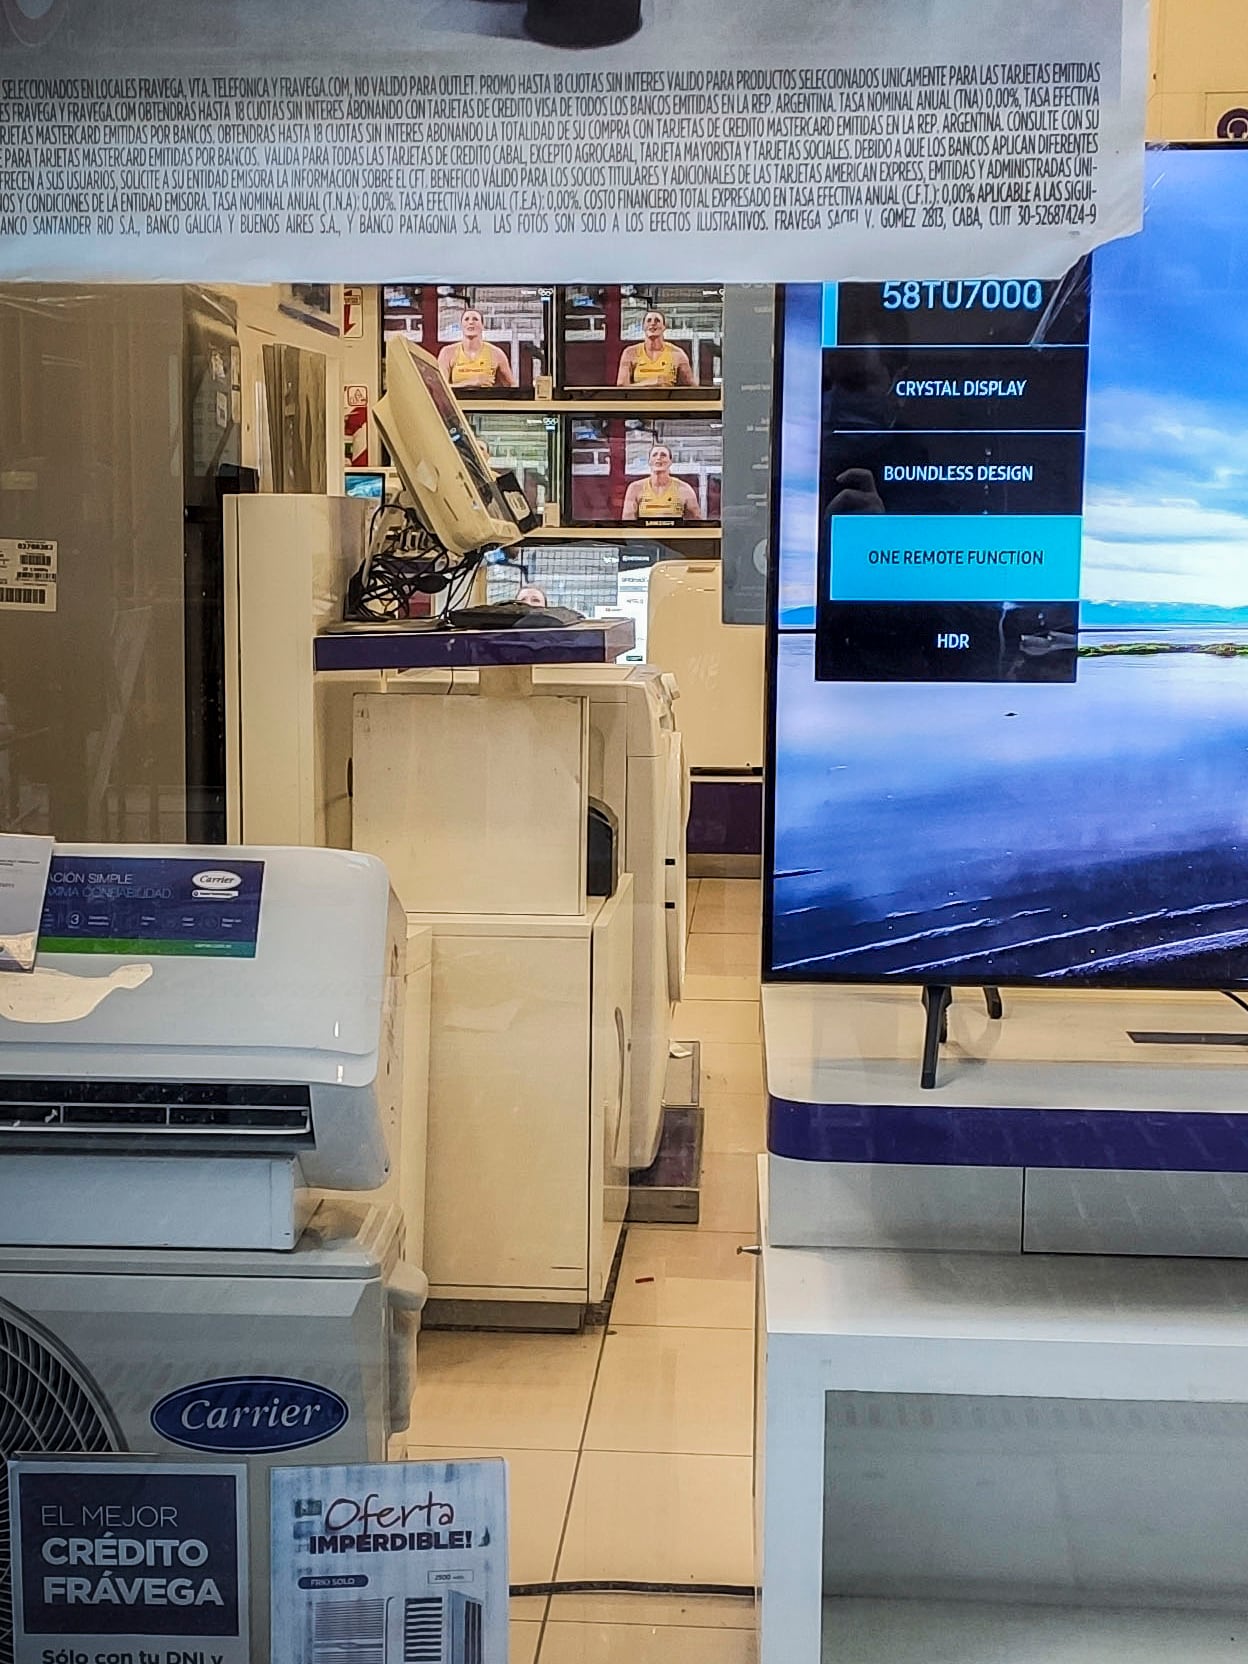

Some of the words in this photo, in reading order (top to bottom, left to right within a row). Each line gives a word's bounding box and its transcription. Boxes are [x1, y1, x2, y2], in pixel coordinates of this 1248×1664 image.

[2, 78, 79, 100] SELECCIONADOS
[80, 78, 94, 99] EN
[95, 77, 137, 99] LOCALES
[138, 77, 188, 102] FRAVEGA,
[189, 77, 210, 98] VTA.
[270, 76, 278, 97] Y
[354, 75, 370, 97] NO
[371, 75, 408, 96] VALIDO
[409, 74, 437, 96] PARA
[439, 73, 478, 96] OUTLET.
[479, 73, 516, 95] PROMO
[517, 72, 550, 94] HASTA
[553, 72, 564, 94] 18
[564, 71, 605, 93] CUOTAS
[606, 71, 623, 93] SIN
[624, 70, 665, 92] INTERES
[667, 70, 704, 92] VALIDO
[705, 70, 734, 91] PARA
[736, 68, 797, 91] PRODUCTOS
[798, 67, 880, 90] SELECCIONADOS
[881, 65, 947, 88] UNICAMENTE
[949, 65, 978, 86] PARA
[979, 64, 999, 86] LAS
[1001, 63, 1051, 85] TARJETAS
[1052, 62, 1101, 84] EMITIDAS
[36, 124, 100, 145] MASTERCARD
[103, 124, 148, 144] EMITIDAS
[151, 124, 171, 144] POR
[173, 124, 215, 144] BANCOS.
[217, 123, 276, 143] OBTENDRAS
[278, 123, 311, 143] HASTA
[313, 123, 323, 143] 18
[325, 122, 364, 143] CUOTAS
[365, 122, 382, 142] SIN
[384, 122, 424, 142] INTERES
[426, 121, 484, 142] ABONANDO
[485, 121, 498, 141] LA
[500, 120, 555, 141] TOTALIDAD
[557, 119, 571, 140] DE
[572, 119, 586, 140] SU
[588, 118, 631, 139] COMPRA
[632, 118, 654, 139] CON
[656, 117, 705, 138] TARJETAS
[707, 117, 721, 138] DE
[722, 116, 765, 137] CREDITO
[767, 115, 835, 136] MASTERCARD
[836, 114, 883, 135] EMITIDAS
[886, 114, 900, 134] EN
[902, 114, 915, 134] LA
[917, 113, 940, 134] REP.
[1007, 110, 1059, 132] CONSULTE
[1061, 110, 1083, 132] CON
[1085, 110, 1100, 131] SU
[120, 169, 160, 189] SOLICITE
[161, 169, 170, 189] A
[171, 169, 185, 189] SU
[187, 169, 228, 189] ENTIDAD
[231, 169, 275, 189] EMISORA
[276, 169, 289, 189] LA
[291, 168, 359, 188] INFORMACION
[361, 168, 394, 188] SOBRE
[395, 168, 407, 188] EL
[430, 167, 480, 188] BENEFICIO
[520, 166, 549, 187] PARA
[32, 215, 92, 235] SANTANDER
[97, 214, 114, 235] RIO
[119, 214, 141, 238] S.A.,
[146, 214, 180, 234] BANCO
[185, 214, 223, 234] GALICIA
[227, 213, 235, 234] Y
[239, 213, 280, 233] BUENOS
[285, 213, 314, 233] AIRES
[319, 213, 341, 237] S.A.,
[347, 213, 355, 234] Y
[359, 213, 394, 234] BANCO
[400, 213, 457, 234] PATAGONIA
[493, 212, 512, 233] LAS
[517, 212, 549, 233] FOTOS
[554, 212, 575, 233] SON
[581, 212, 607, 233] SOLO
[612, 211, 620, 232] A
[625, 211, 644, 232] LOS
[649, 211, 691, 232] EFECTOS
[696, 209, 769, 232] ILUSTRATIVOS.
[774, 208, 822, 230] FRAVEGA
[921, 206, 947, 231] 2813,
[952, 205, 984, 230] CABA,
[989, 205, 1011, 226] CUIT
[1017, 203, 1097, 226] 30-52687424-9
[882, 280, 1043, 310] 58TU7000
[896, 380, 961, 397] CRYSTAL
[963, 380, 1027, 397] DISPLAY
[884, 466, 974, 482] BOUNDLESS
[977, 466, 1034, 482] DESIGN
[868, 550, 901, 566] ONE
[903, 550, 965, 566] REMOTE
[967, 550, 1044, 566] FUNCTION
[937, 633, 970, 649] HDR
[88, 873, 133, 885] SIMPLE
[199, 875, 236, 885] Carrier
[71, 914, 79, 925] 3
[180, 1397, 322, 1430] Carrier
[41, 1505, 76, 1528] EL
[82, 1505, 178, 1528] MEJOR
[325, 1491, 455, 1534] Oferta
[41, 1531, 209, 1568] CRÉDITO
[309, 1531, 472, 1555] IMPERDIBLE!
[42, 1570, 225, 1607] FRÁVEGA
[42, 1648, 88, 1664] Sólo
[94, 1652, 132, 1664] con
[139, 1650, 160, 1664] tu
[166, 1651, 204, 1664] DNI
